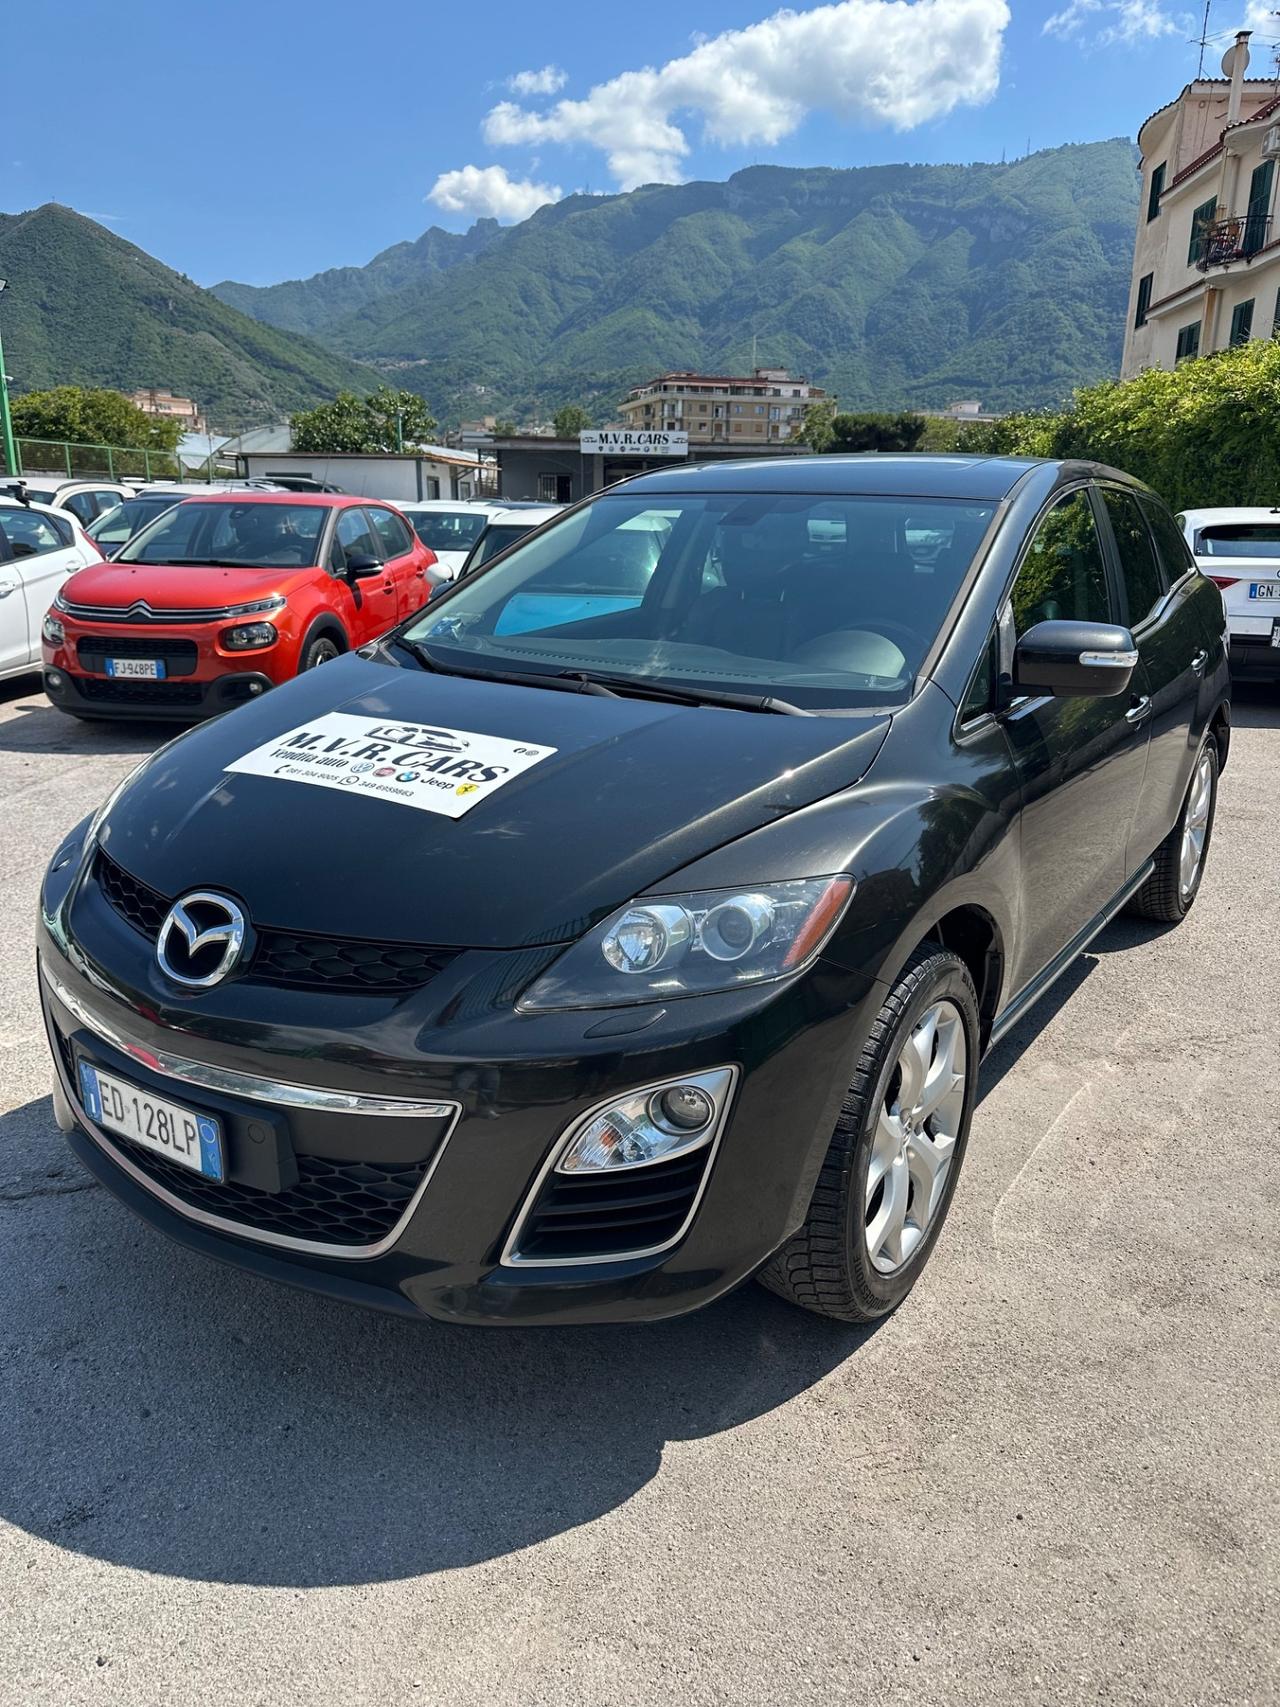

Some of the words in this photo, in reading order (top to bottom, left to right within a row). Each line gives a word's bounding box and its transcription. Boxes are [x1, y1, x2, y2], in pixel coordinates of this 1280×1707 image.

[637, 433, 670, 445] CARS
[270, 748, 319, 763] Vendita
[316, 756, 349, 768] auto
[392, 750, 510, 783] CARS
[420, 777, 455, 790] Jeep
